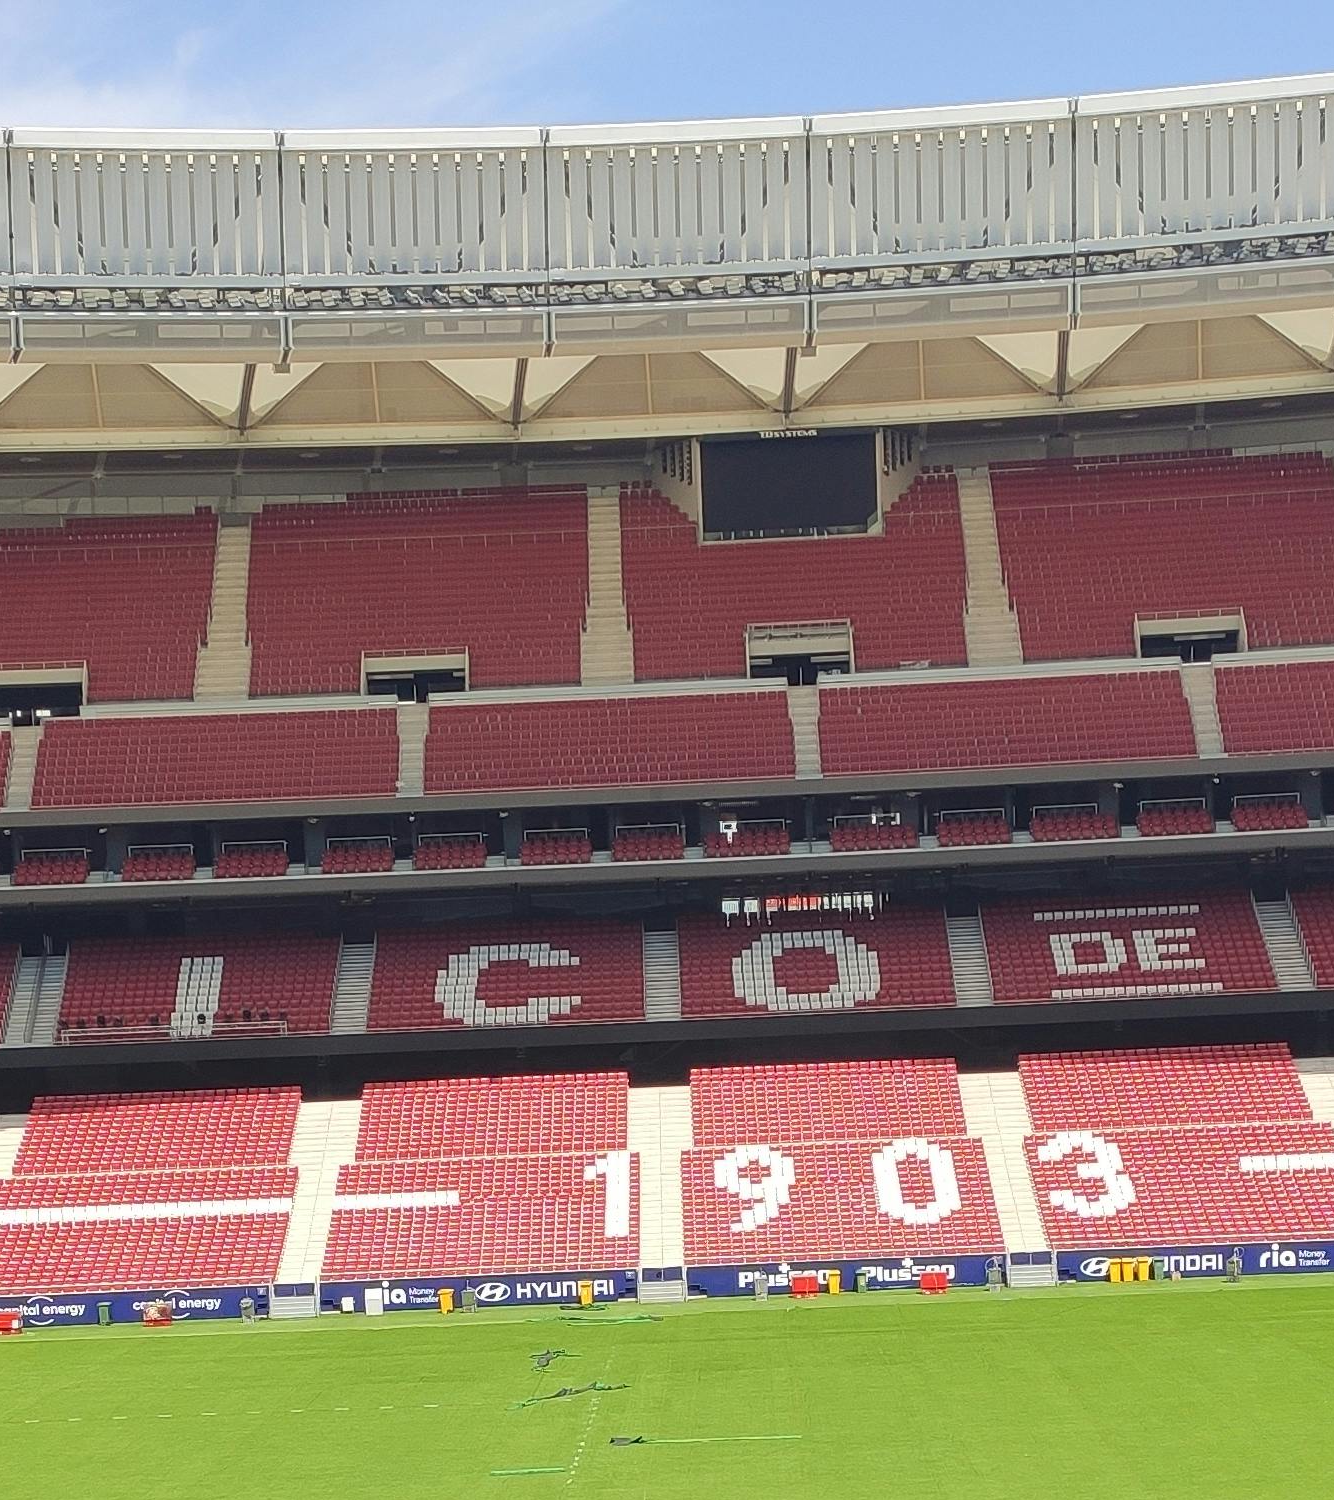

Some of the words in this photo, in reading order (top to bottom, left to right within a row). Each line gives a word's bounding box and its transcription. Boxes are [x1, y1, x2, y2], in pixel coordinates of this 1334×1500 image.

[1050, 929, 1206, 976] DE
[1163, 1254, 1223, 1272] NDAI
[1260, 1243, 1296, 1267] ria
[1299, 1250, 1326, 1258] Money
[517, 1280, 614, 1299] HYUNAI
[43, 1304, 85, 1316] energy
[179, 1299, 221, 1310] energy
